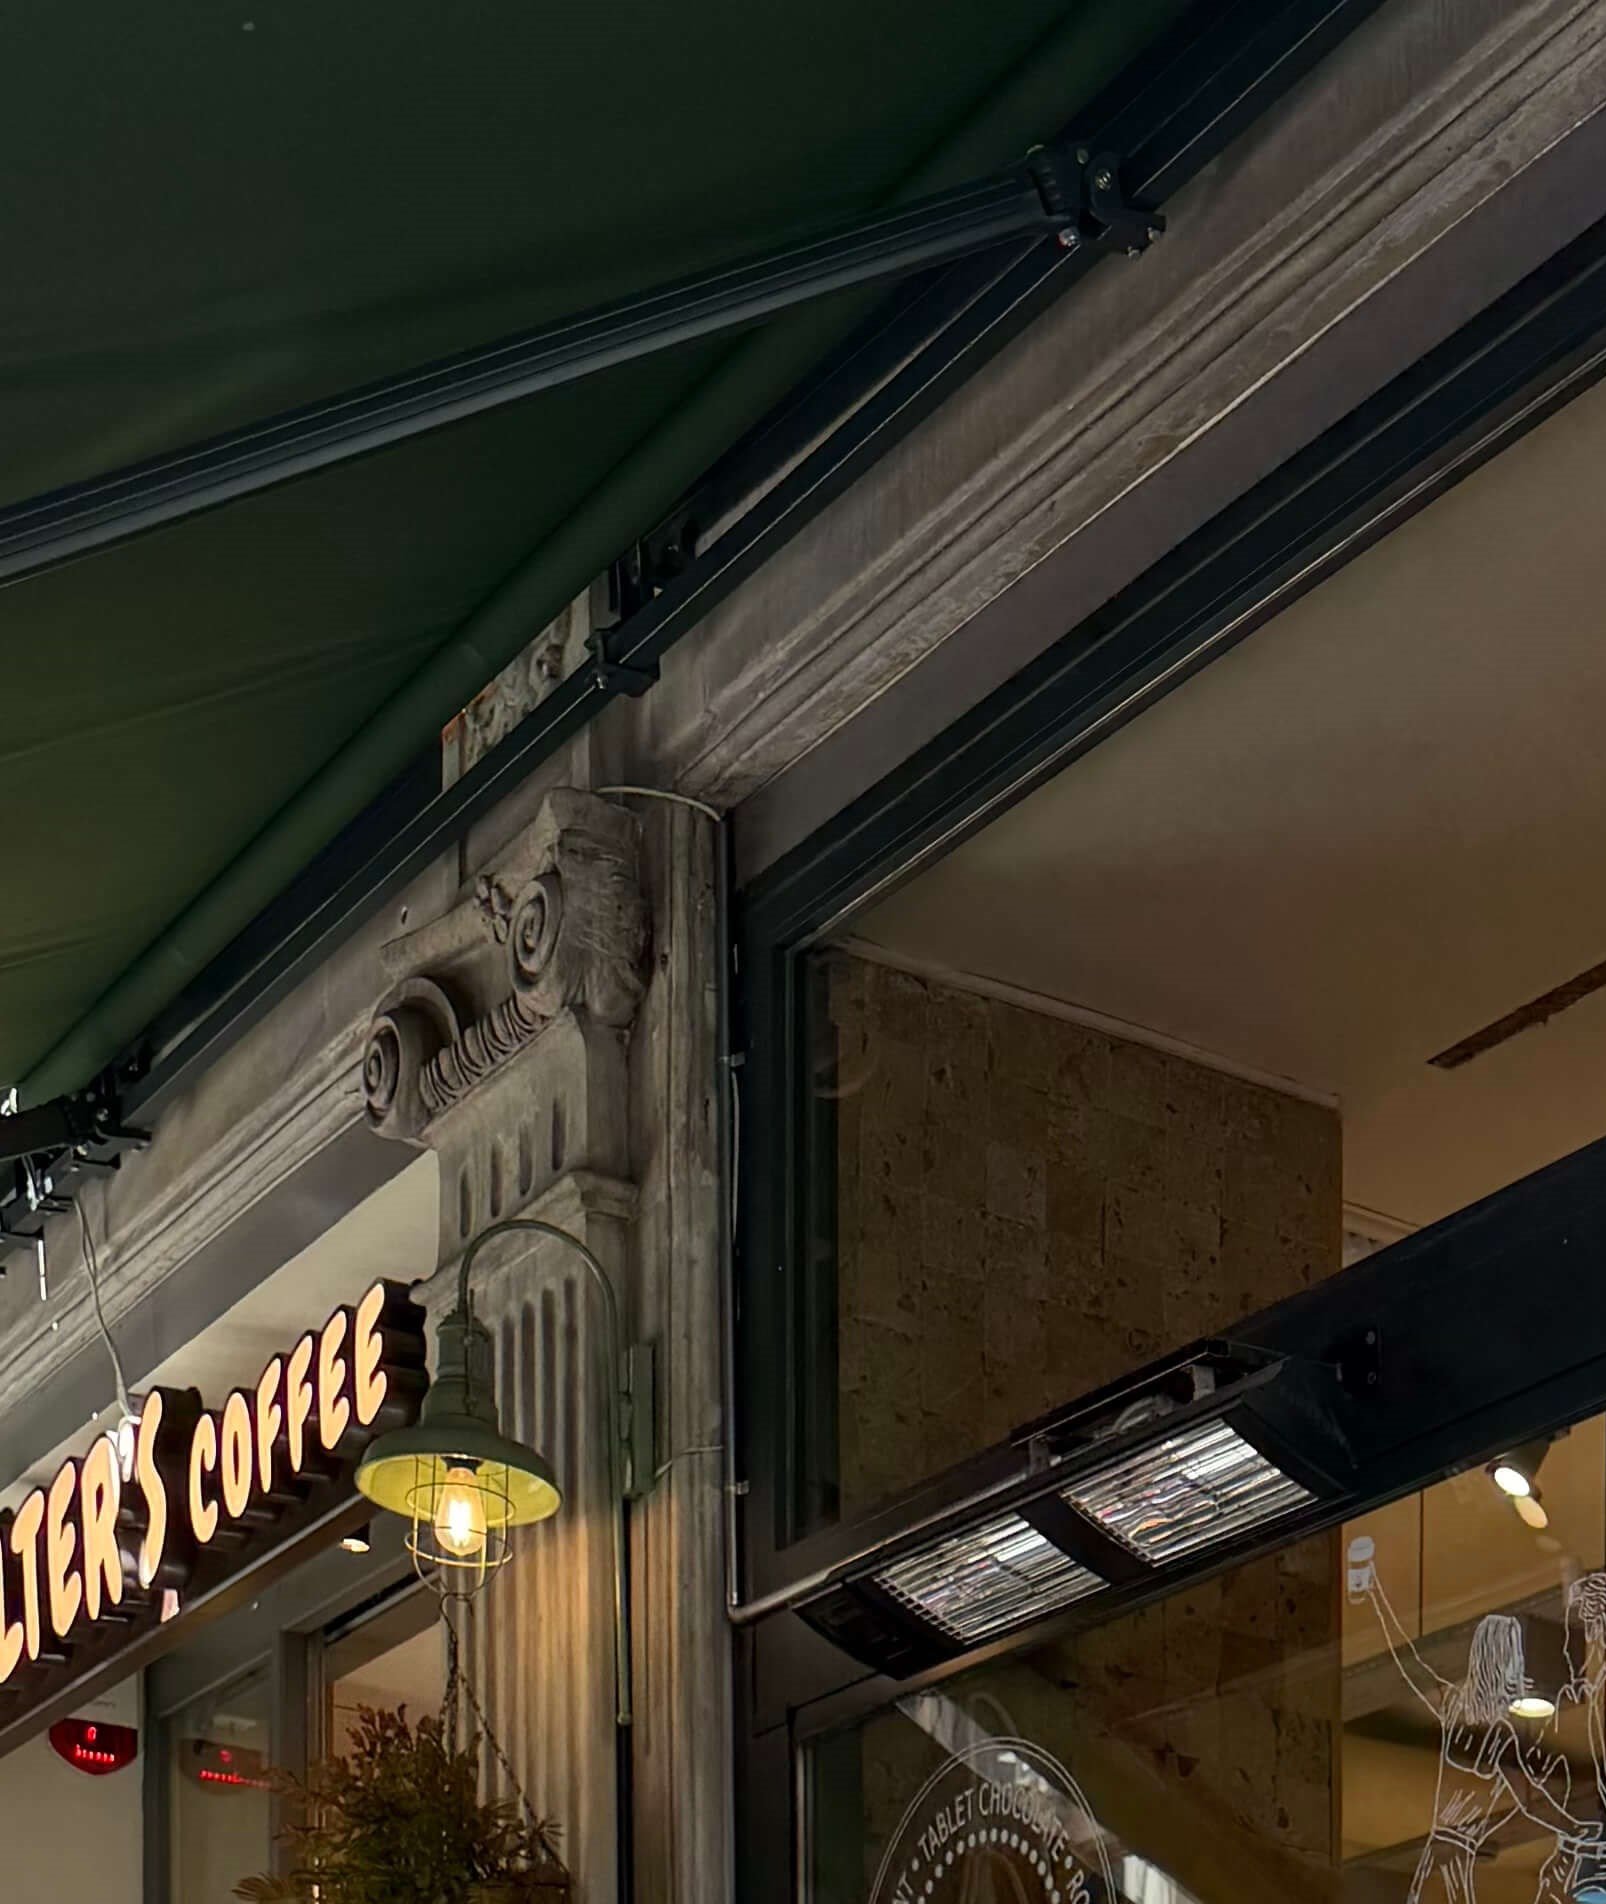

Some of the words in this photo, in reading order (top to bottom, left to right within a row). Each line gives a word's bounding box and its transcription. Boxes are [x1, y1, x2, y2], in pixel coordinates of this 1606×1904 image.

[189, 1282, 388, 1544] COFFEE
[917, 1787, 975, 1862] TABLET
[979, 1782, 1070, 1862] CHOCOLATE
